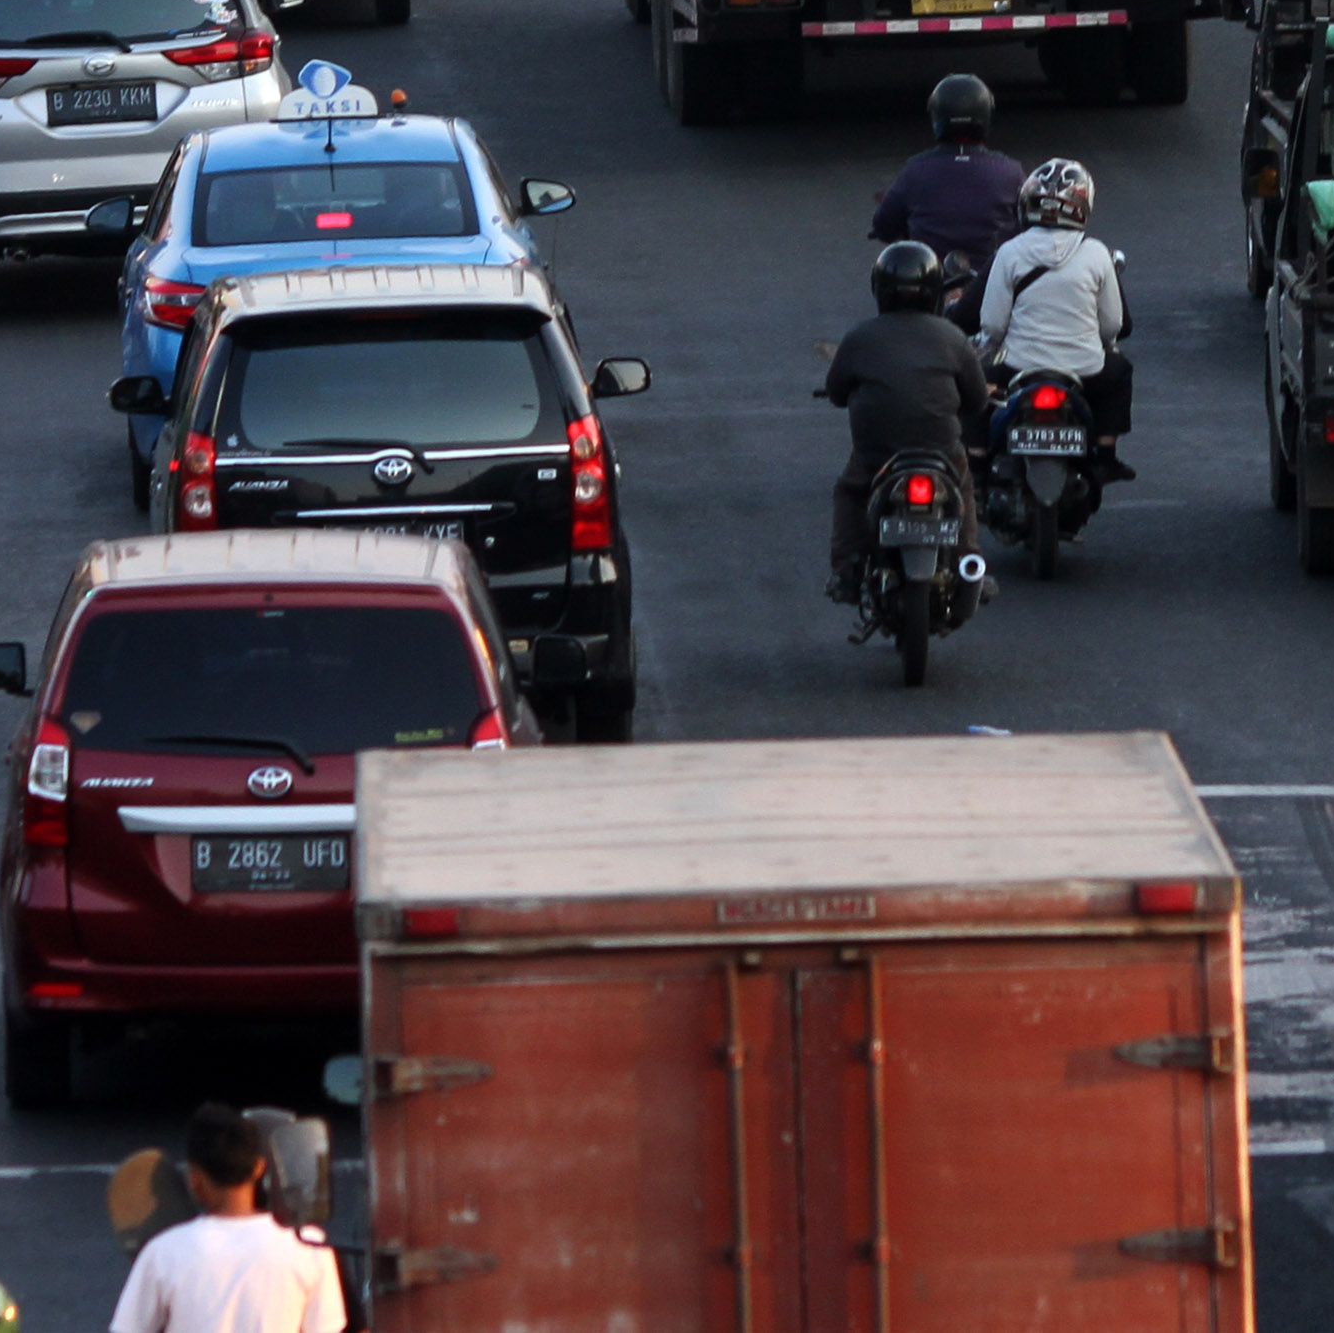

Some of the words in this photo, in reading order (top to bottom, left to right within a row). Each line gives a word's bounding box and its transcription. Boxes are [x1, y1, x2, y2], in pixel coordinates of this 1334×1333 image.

[53, 90, 64, 111] B
[73, 88, 112, 110] 2230
[120, 85, 151, 106] KKM
[293, 99, 361, 115] TAKSI
[228, 479, 290, 493] AVANZA
[80, 776, 155, 789] AVANZA
[195, 840, 212, 869] B
[227, 841, 283, 868] 2862
